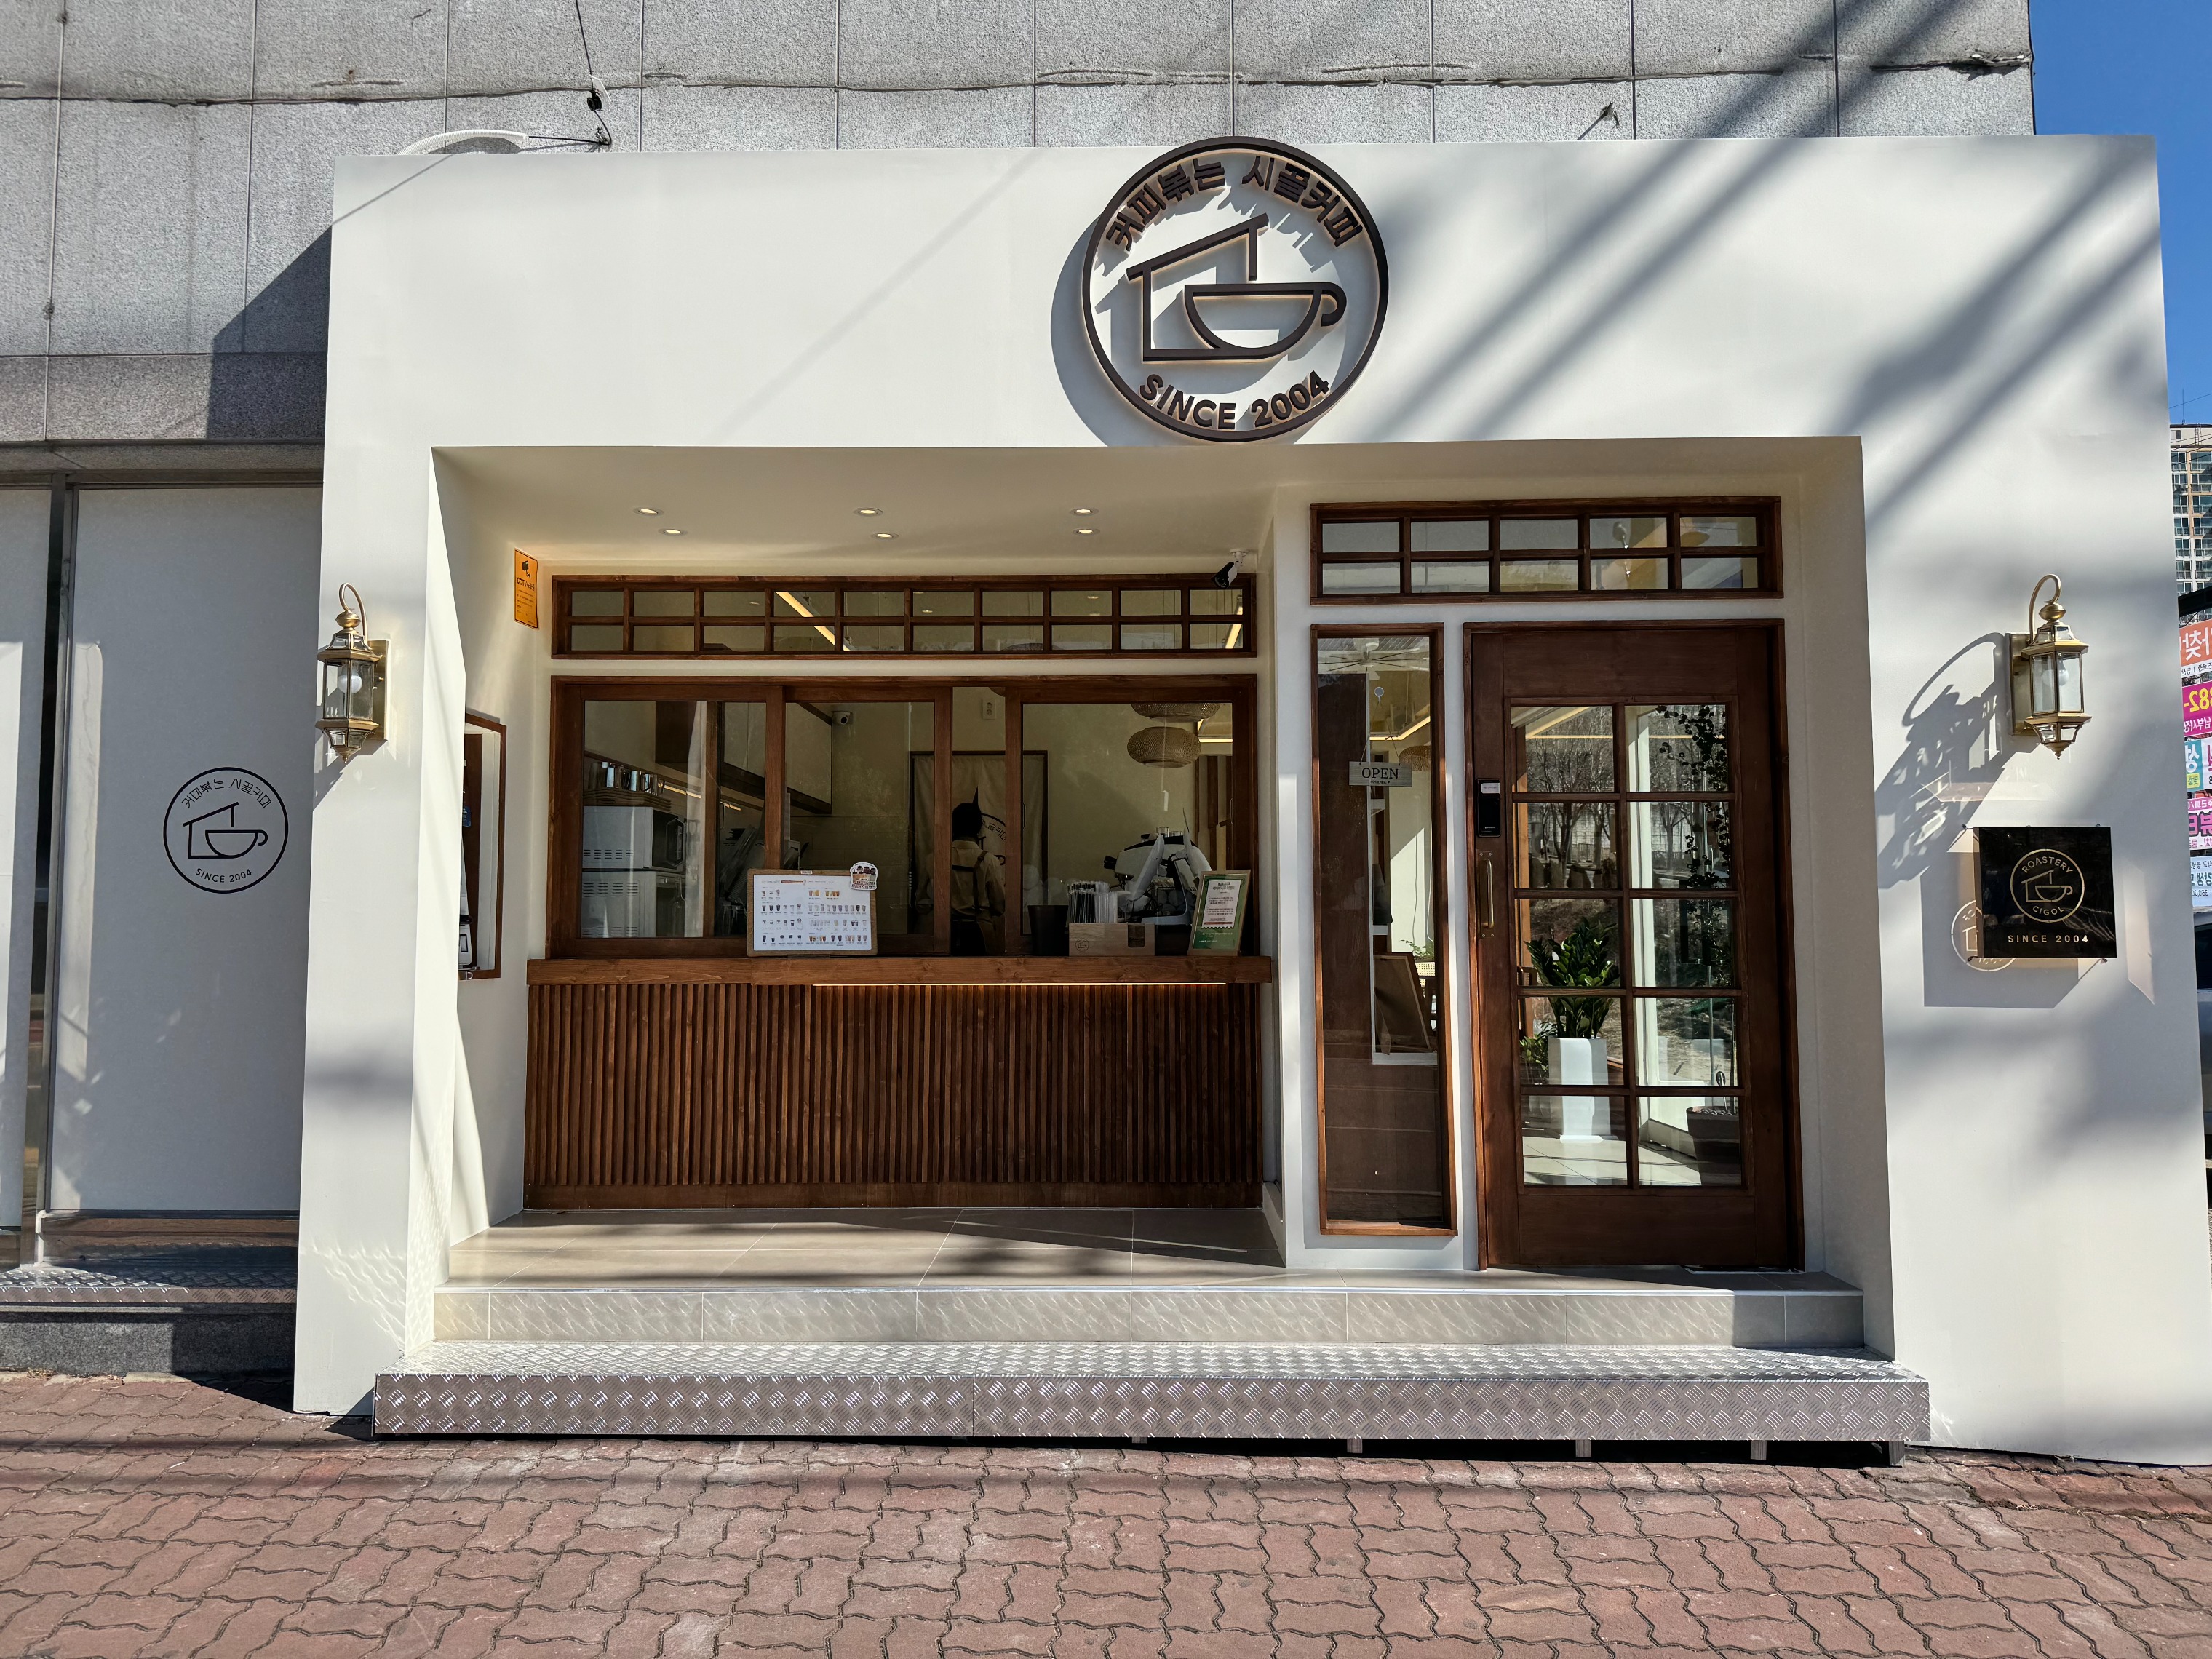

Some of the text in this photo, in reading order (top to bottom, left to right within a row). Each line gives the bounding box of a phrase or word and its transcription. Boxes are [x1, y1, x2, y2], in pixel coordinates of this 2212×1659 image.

[1105, 156, 1364, 252] 커피볶는 시골커피
[1139, 370, 1329, 429] SINCE 2004
[1362, 768, 1399, 779] OPEN
[181, 778, 271, 808] 커피볶는 시골커피
[2021, 856, 2073, 874] ROASTERY
[195, 867, 252, 883] SINCE 2004
[2032, 906, 2064, 915] CIGOL
[2008, 935, 2088, 943] SINCE 2004
